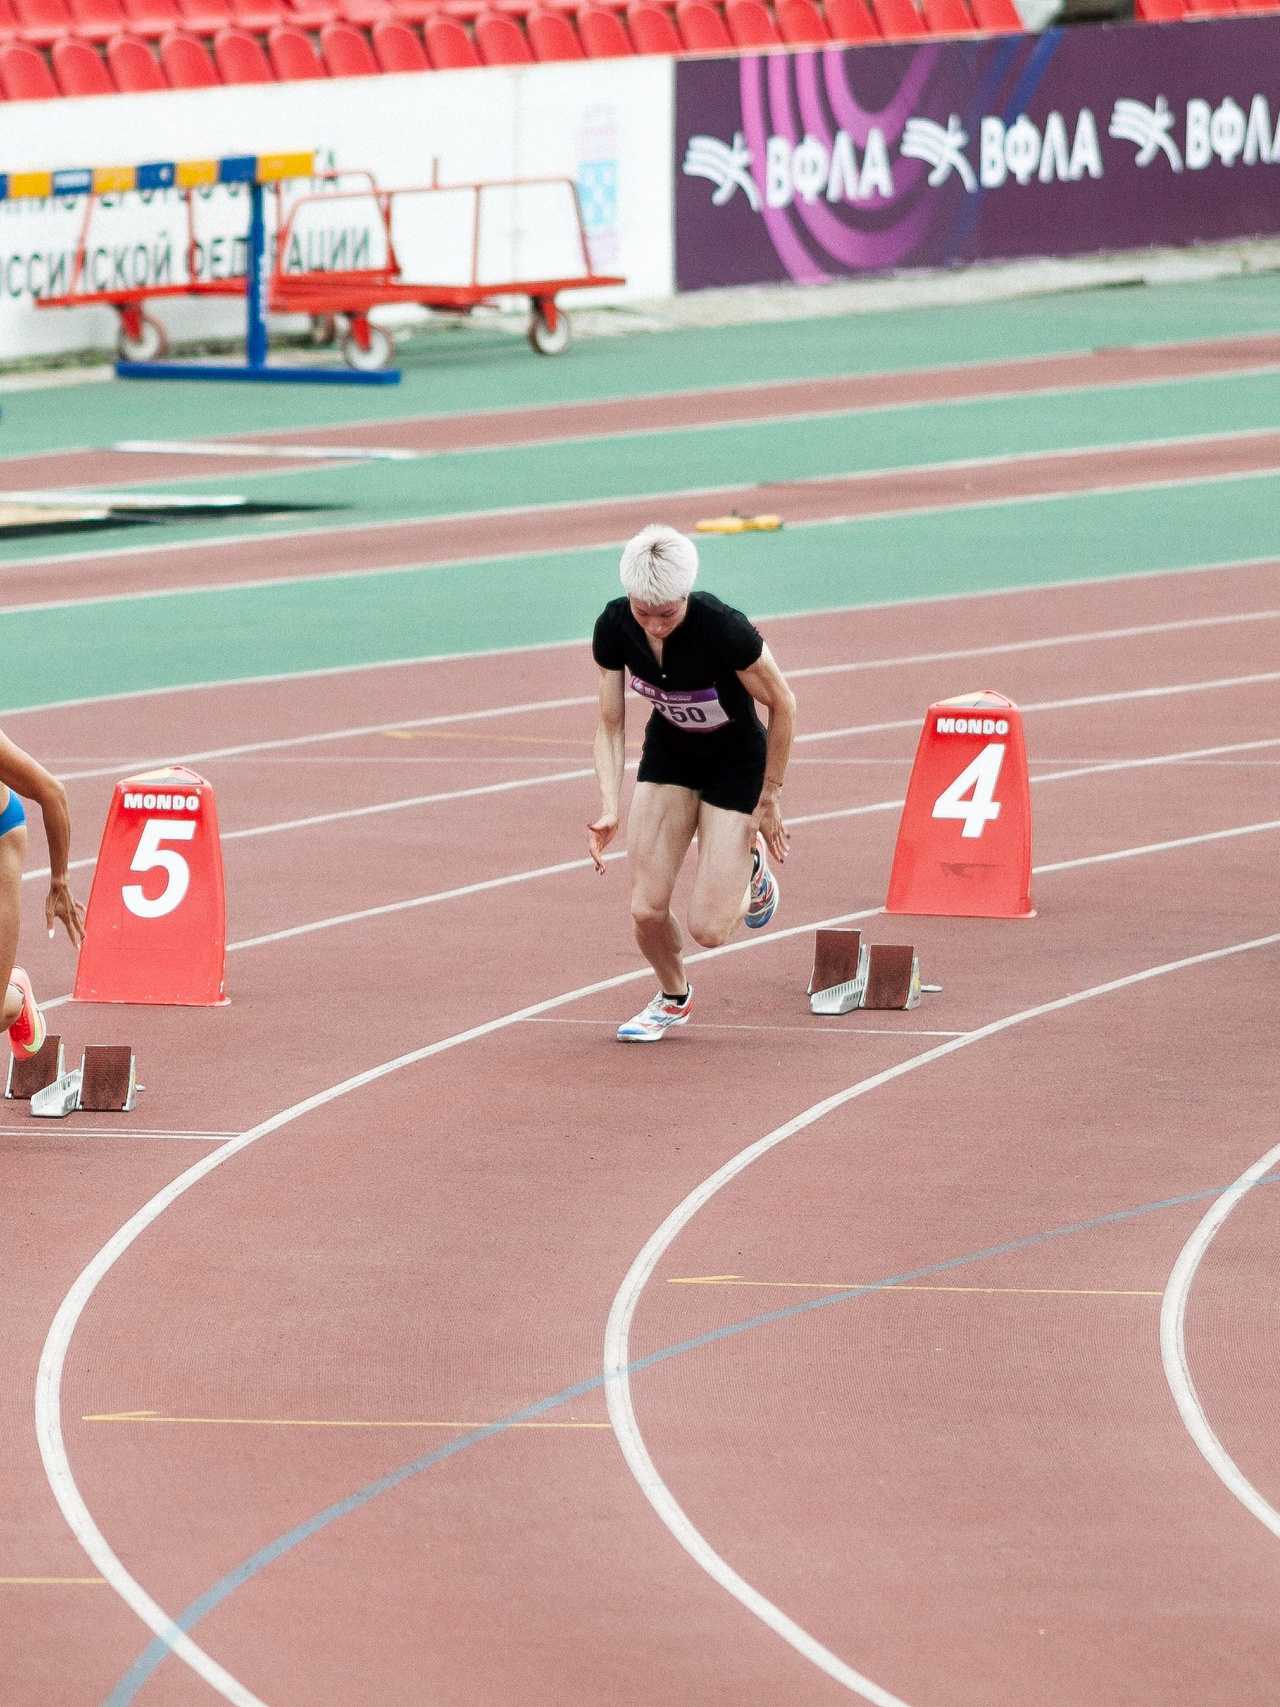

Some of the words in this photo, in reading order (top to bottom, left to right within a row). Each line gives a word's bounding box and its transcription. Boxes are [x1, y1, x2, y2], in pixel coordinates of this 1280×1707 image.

[766, 125, 894, 209] ВФЛА
[980, 107, 1105, 189] ВФЛА
[1185, 92, 1280, 171] ВФЛ
[936, 717, 1010, 735] MONDO
[123, 793, 200, 811] MONDO
[931, 742, 1006, 838] 4
[121, 818, 197, 918] 5
